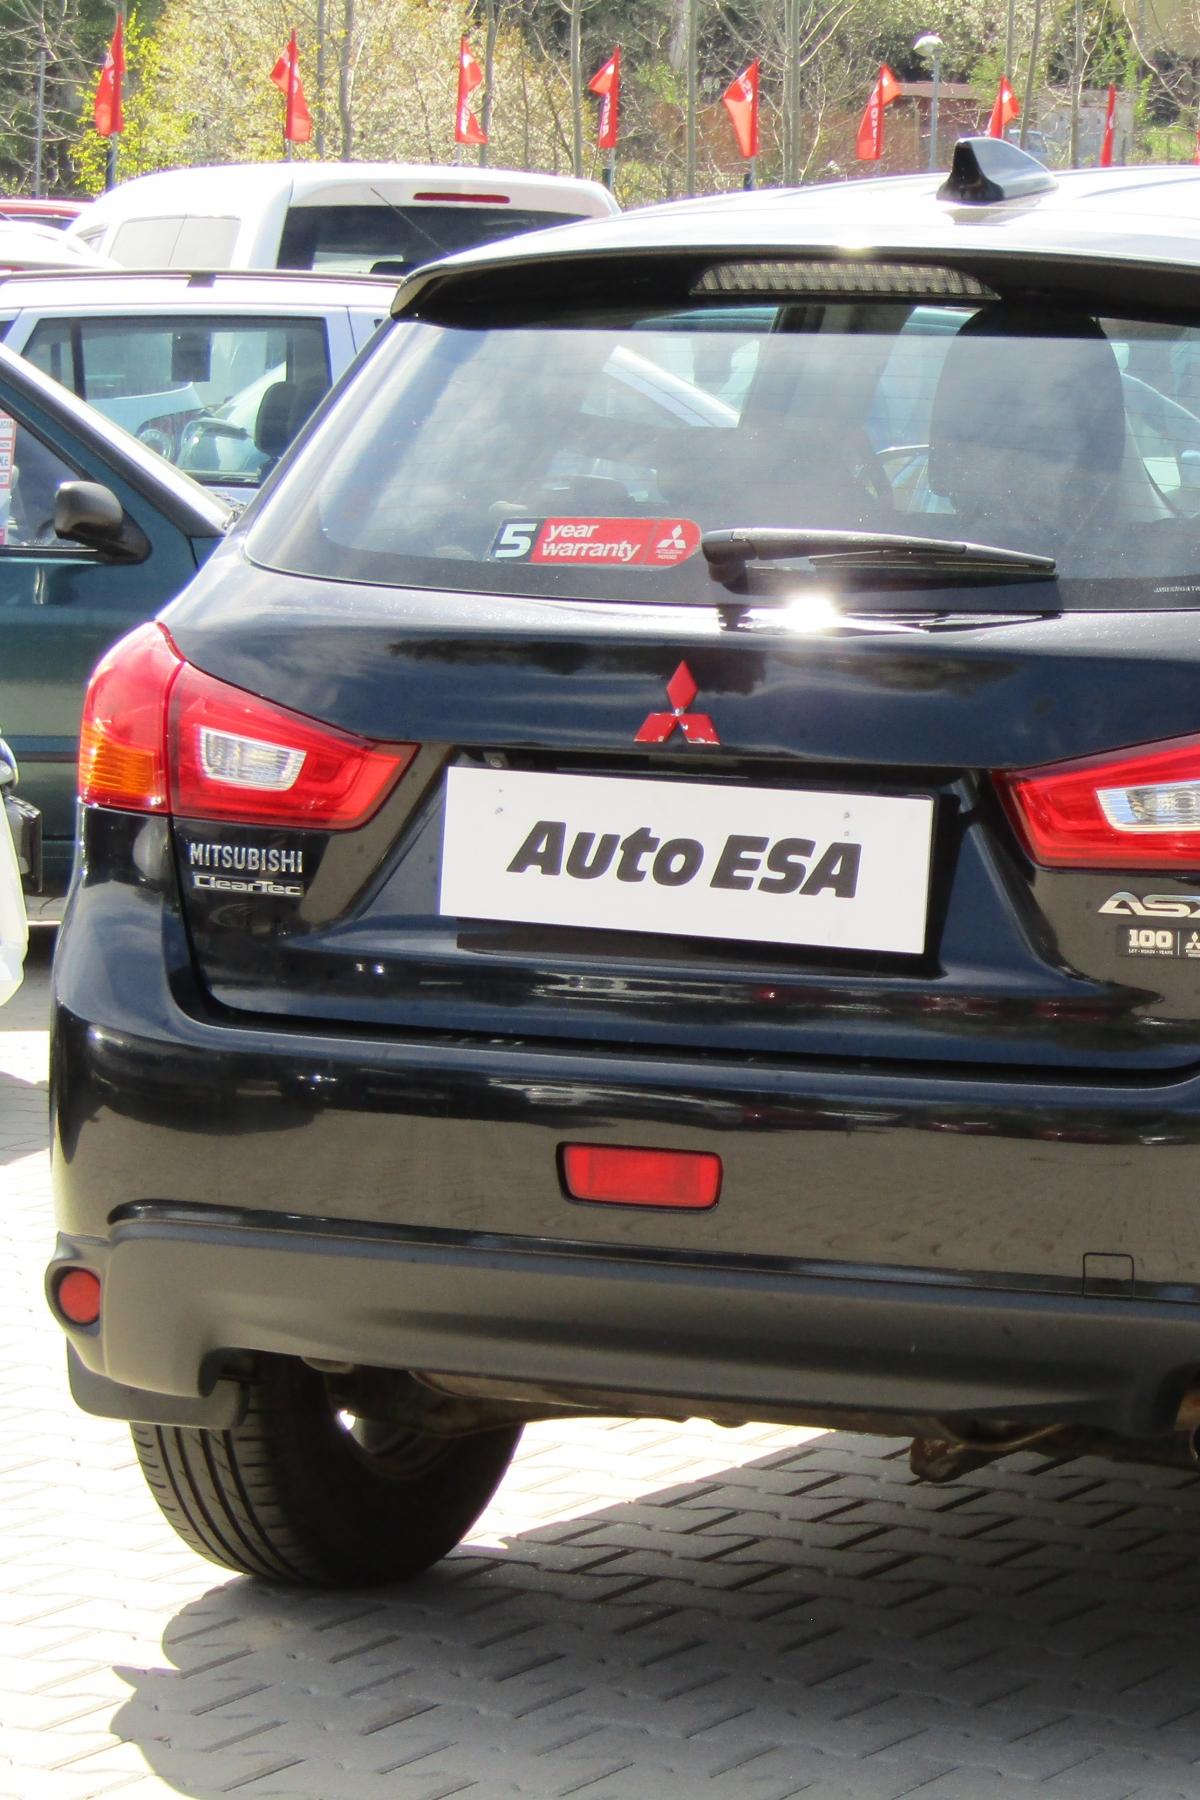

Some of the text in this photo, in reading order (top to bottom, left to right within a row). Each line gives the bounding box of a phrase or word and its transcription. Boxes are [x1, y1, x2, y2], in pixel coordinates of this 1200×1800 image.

[494, 523, 600, 558] 5 year
[541, 541, 641, 561] warranty
[190, 843, 303, 873] MITSUBISHI
[506, 819, 863, 899] Auto ESA
[194, 875, 302, 896] ClearTec
[1129, 929, 1174, 948] 100
